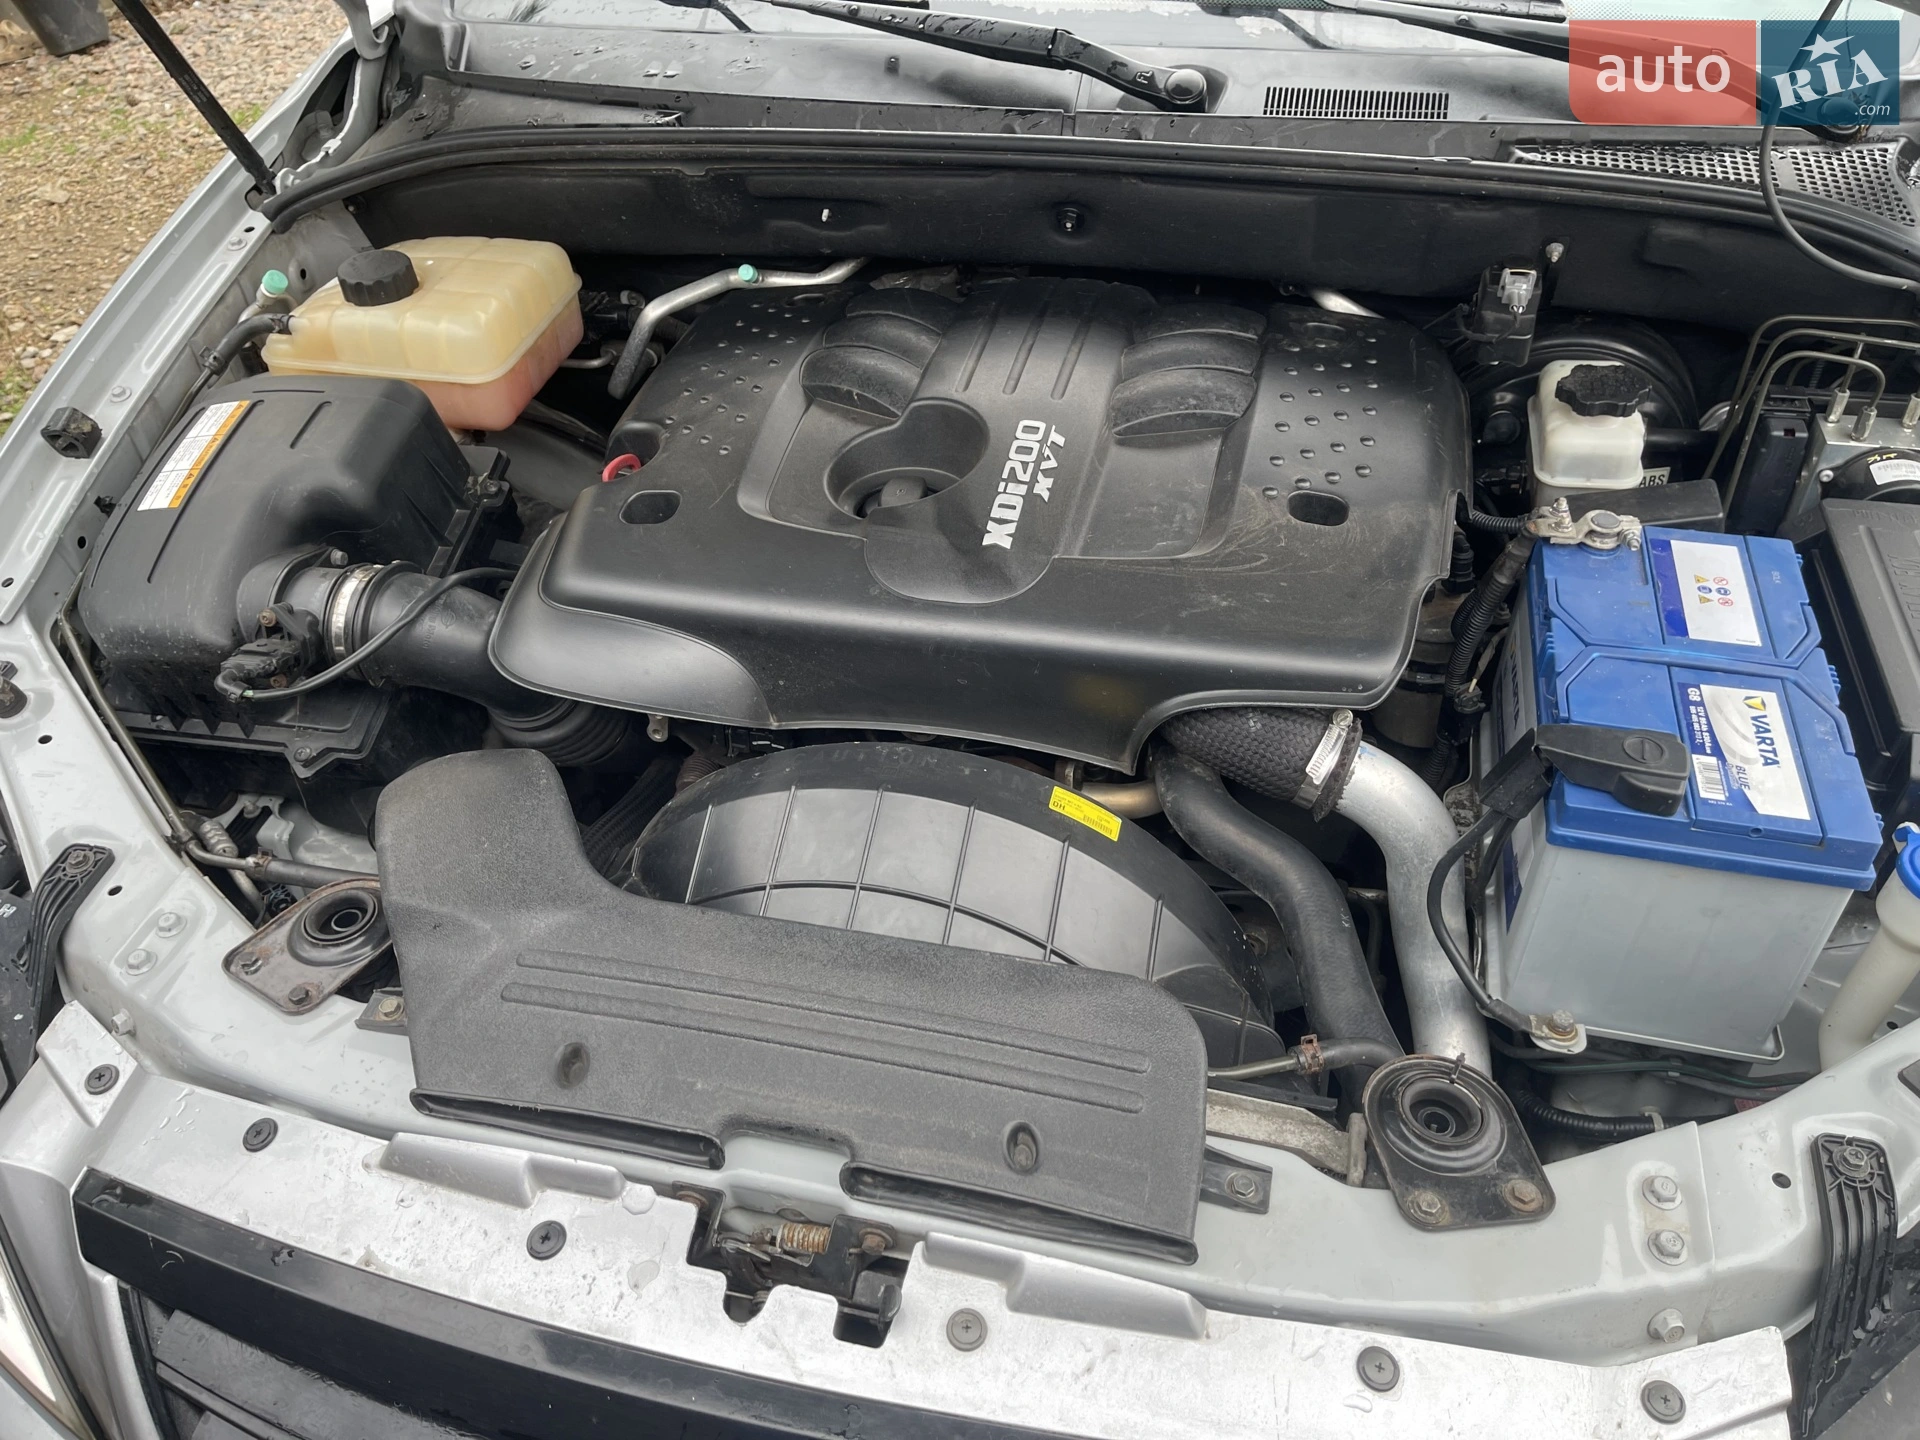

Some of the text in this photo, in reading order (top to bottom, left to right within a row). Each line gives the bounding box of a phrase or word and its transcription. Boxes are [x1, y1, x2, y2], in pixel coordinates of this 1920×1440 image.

[1033, 424, 1066, 503] XVT
[1639, 474, 1665, 488] ABS
[982, 419, 1046, 550] XDi200
[1687, 687, 1701, 702] G8
[1750, 714, 1780, 767] VARTA
[1735, 765, 1751, 790] BLUE
